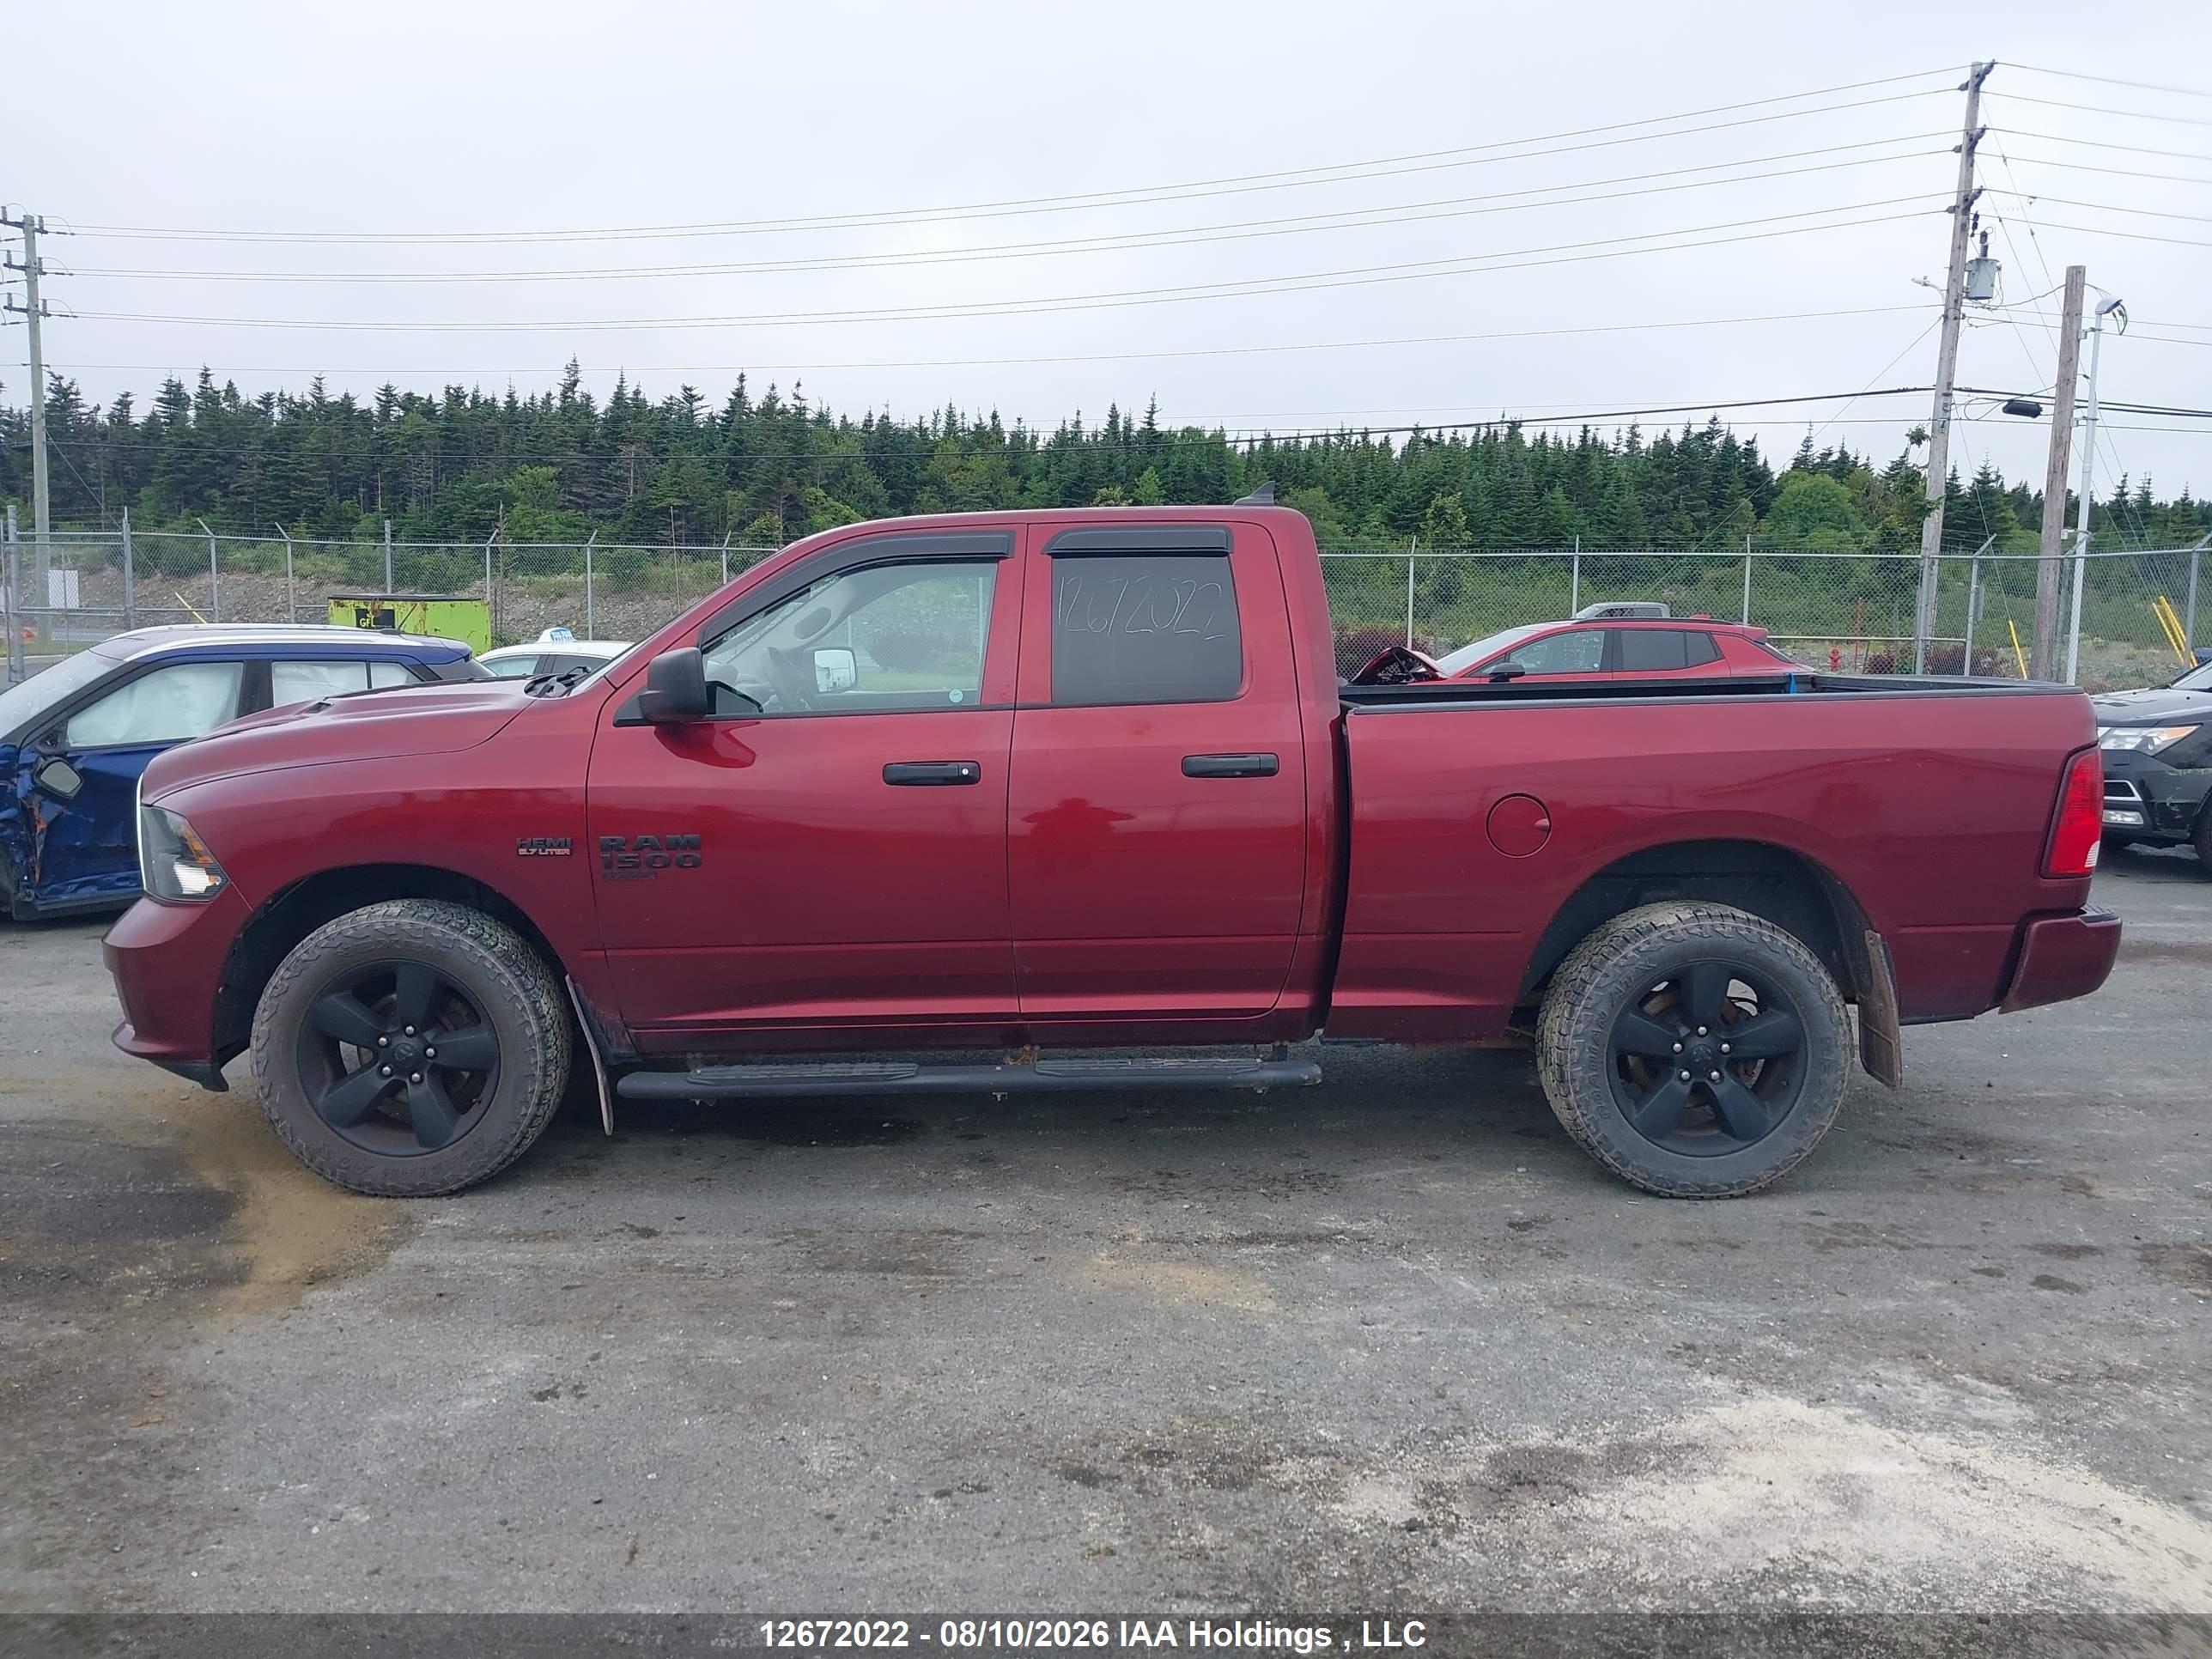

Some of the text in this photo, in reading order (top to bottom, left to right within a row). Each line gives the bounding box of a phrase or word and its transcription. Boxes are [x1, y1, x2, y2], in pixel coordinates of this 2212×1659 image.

[516, 837, 572, 849] HEMI
[599, 834, 702, 852] RAM
[600, 853, 702, 869] 1500
